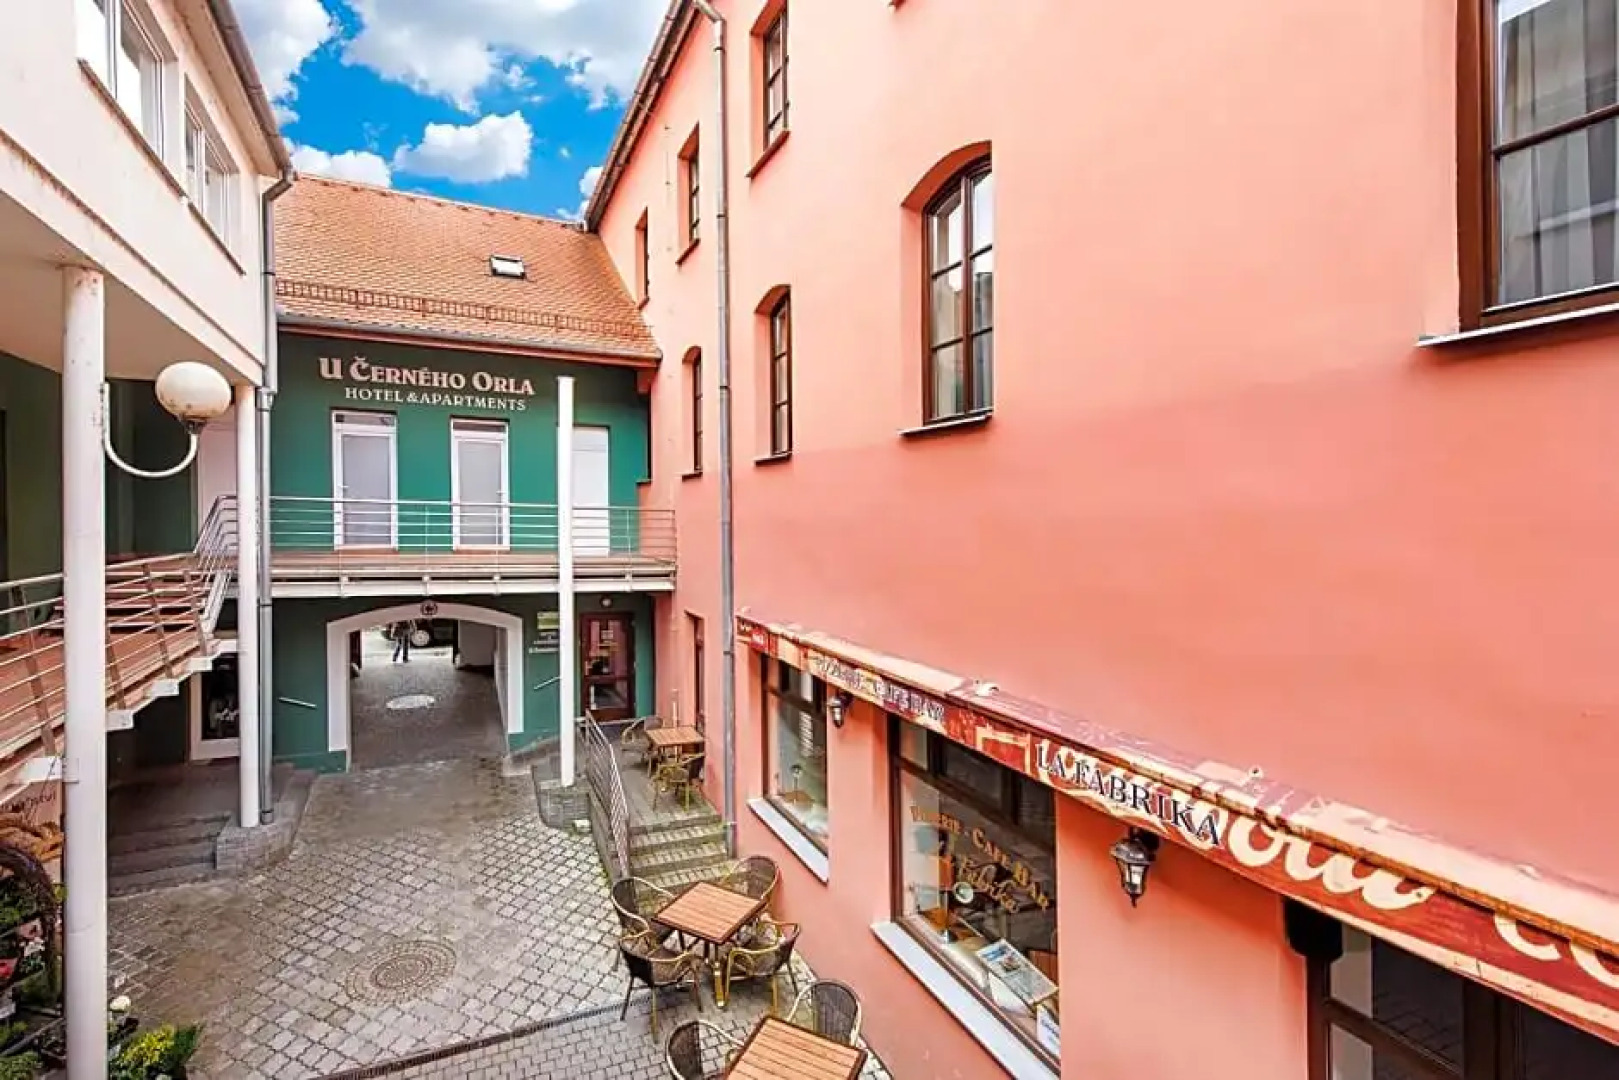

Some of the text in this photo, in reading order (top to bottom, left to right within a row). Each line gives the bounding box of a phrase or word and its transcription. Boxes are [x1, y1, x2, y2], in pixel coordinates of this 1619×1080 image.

[318, 355, 535, 396] U ČERNÉHO ORLA
[344, 387, 404, 403] HOTEL
[1035, 743, 1221, 846] LA FABRIKA
